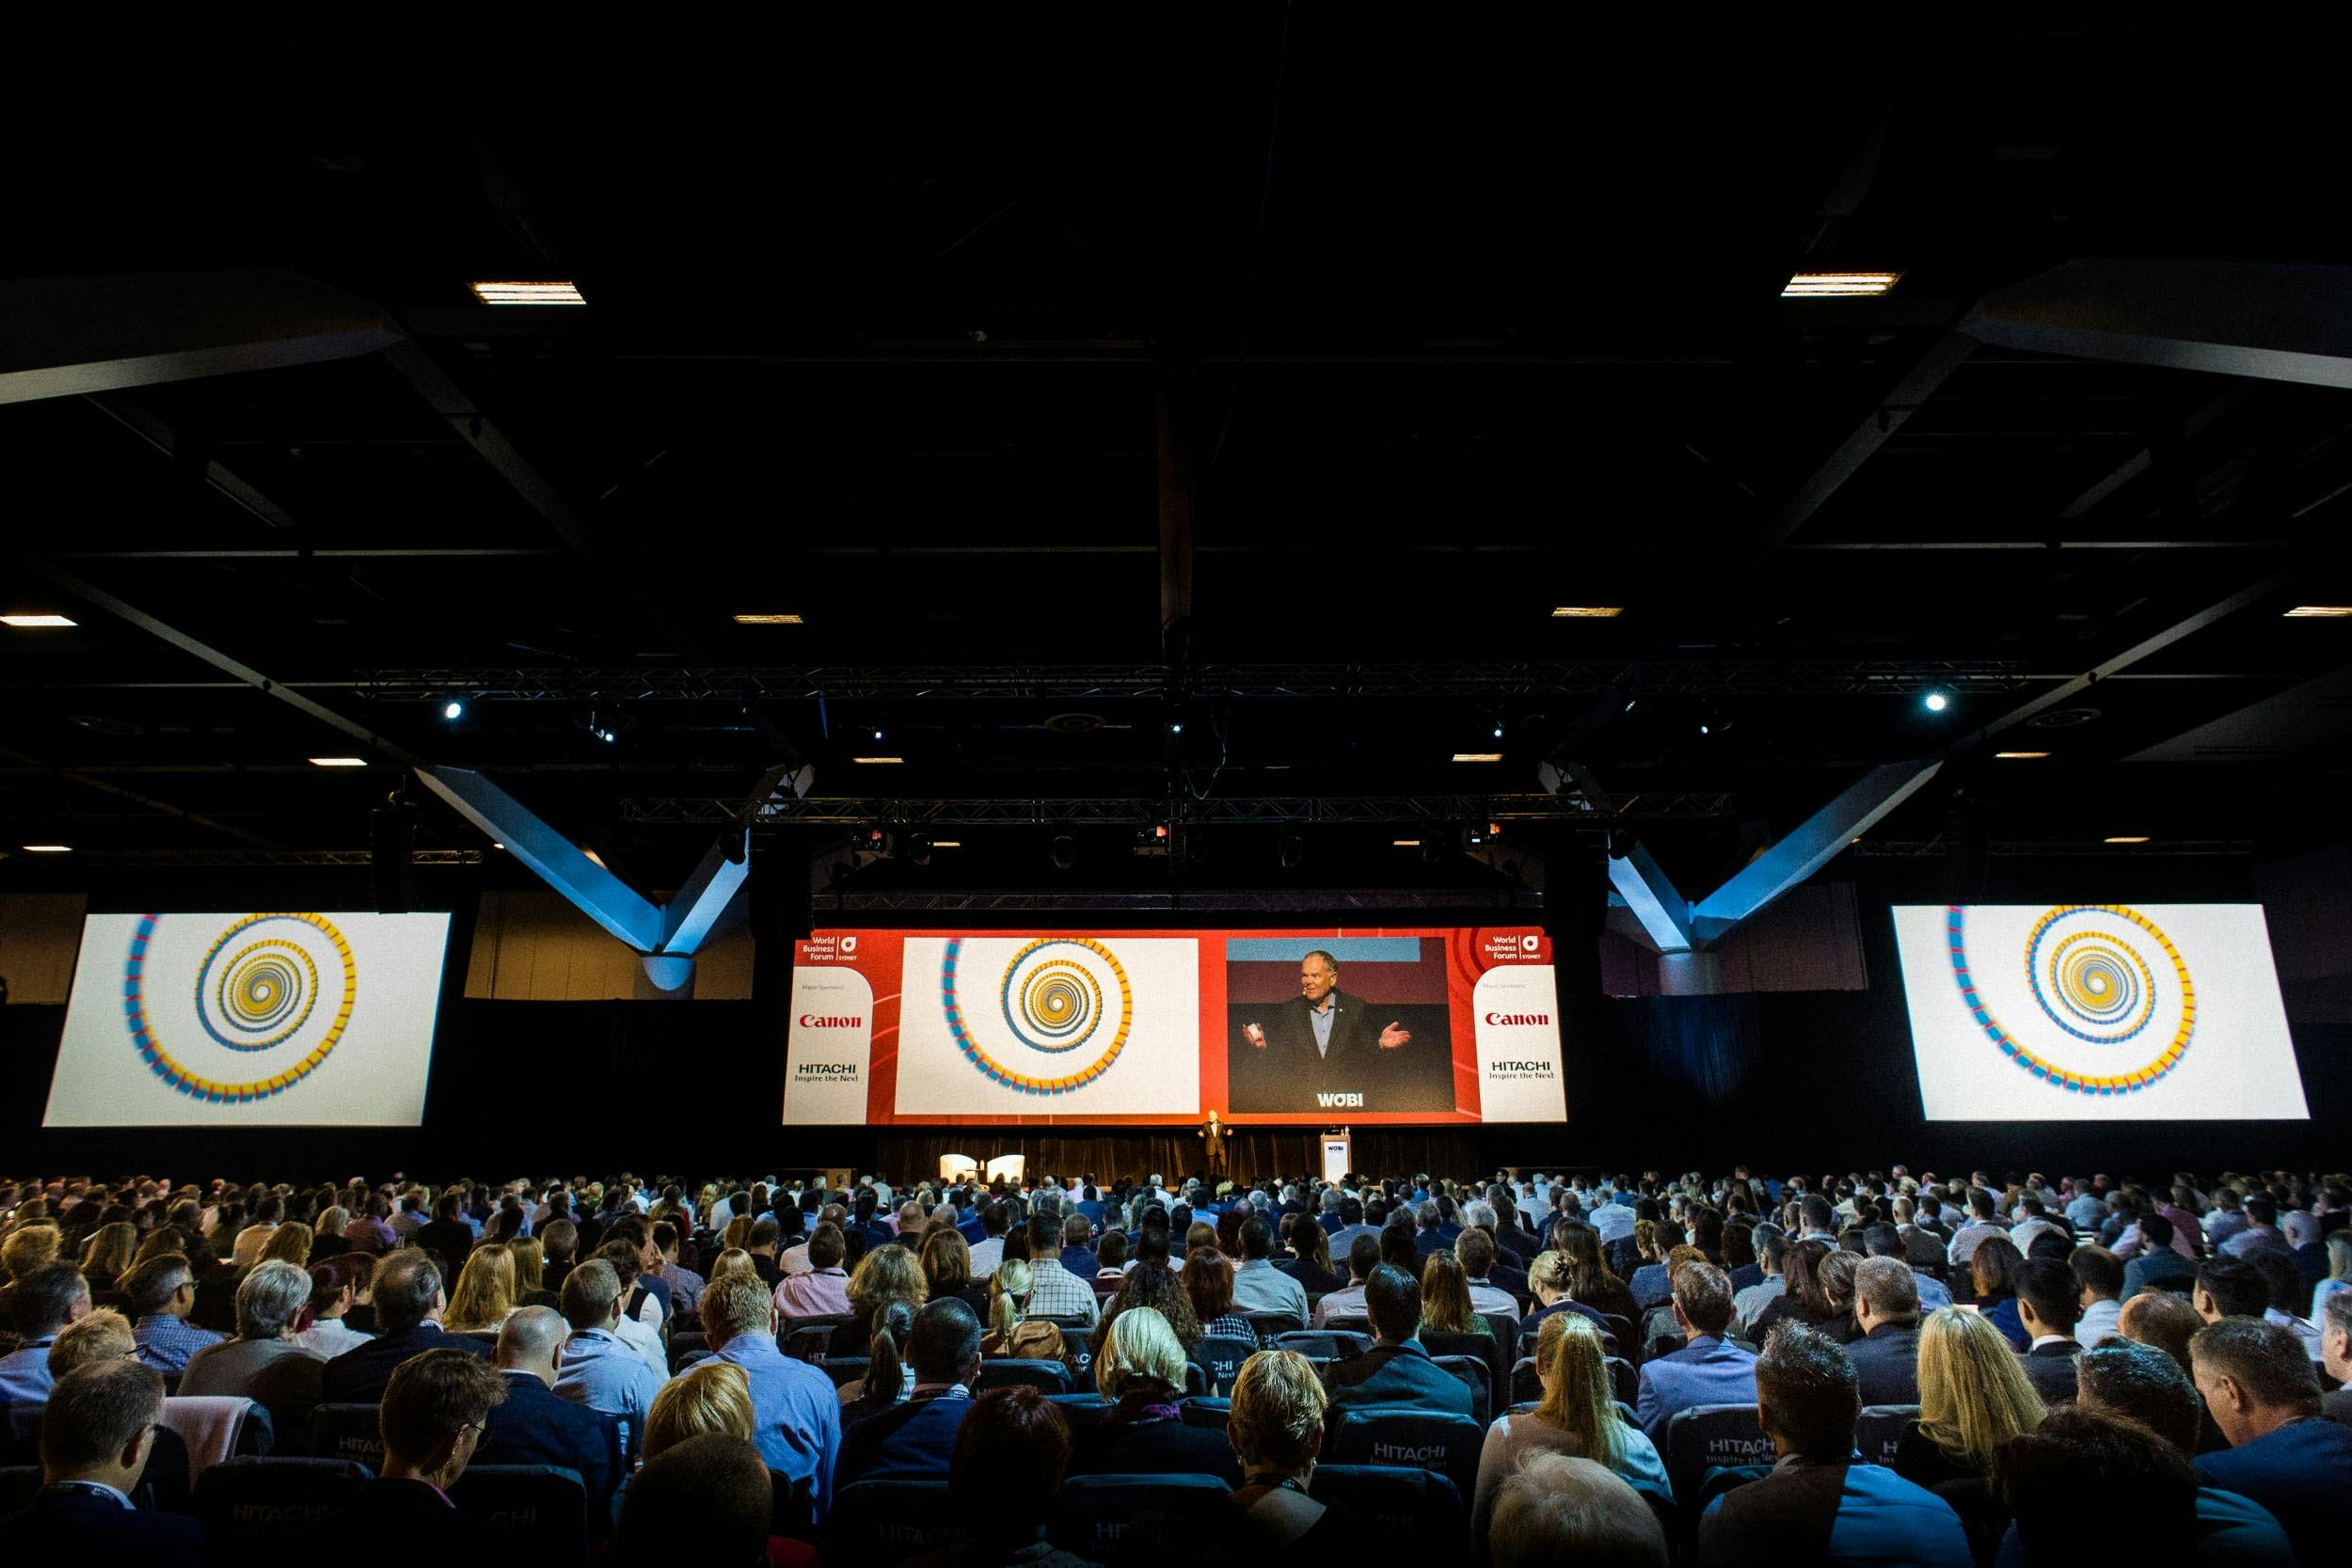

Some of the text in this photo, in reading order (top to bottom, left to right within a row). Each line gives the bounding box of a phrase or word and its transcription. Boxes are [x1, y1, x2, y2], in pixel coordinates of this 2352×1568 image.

[812, 936, 835, 944] World
[799, 1015, 862, 1028] Canon
[1485, 1013, 1549, 1025] Canon
[799, 1064, 856, 1073] HITACHI
[1492, 1061, 1550, 1070] HITACHI
[795, 1074, 823, 1084] Inspire
[1489, 1072, 1518, 1081] Inspire
[1317, 1093, 1363, 1107] WOBI
[1374, 1442, 1446, 1461] HITACHI
[1709, 1438, 1775, 1454] HITACH
